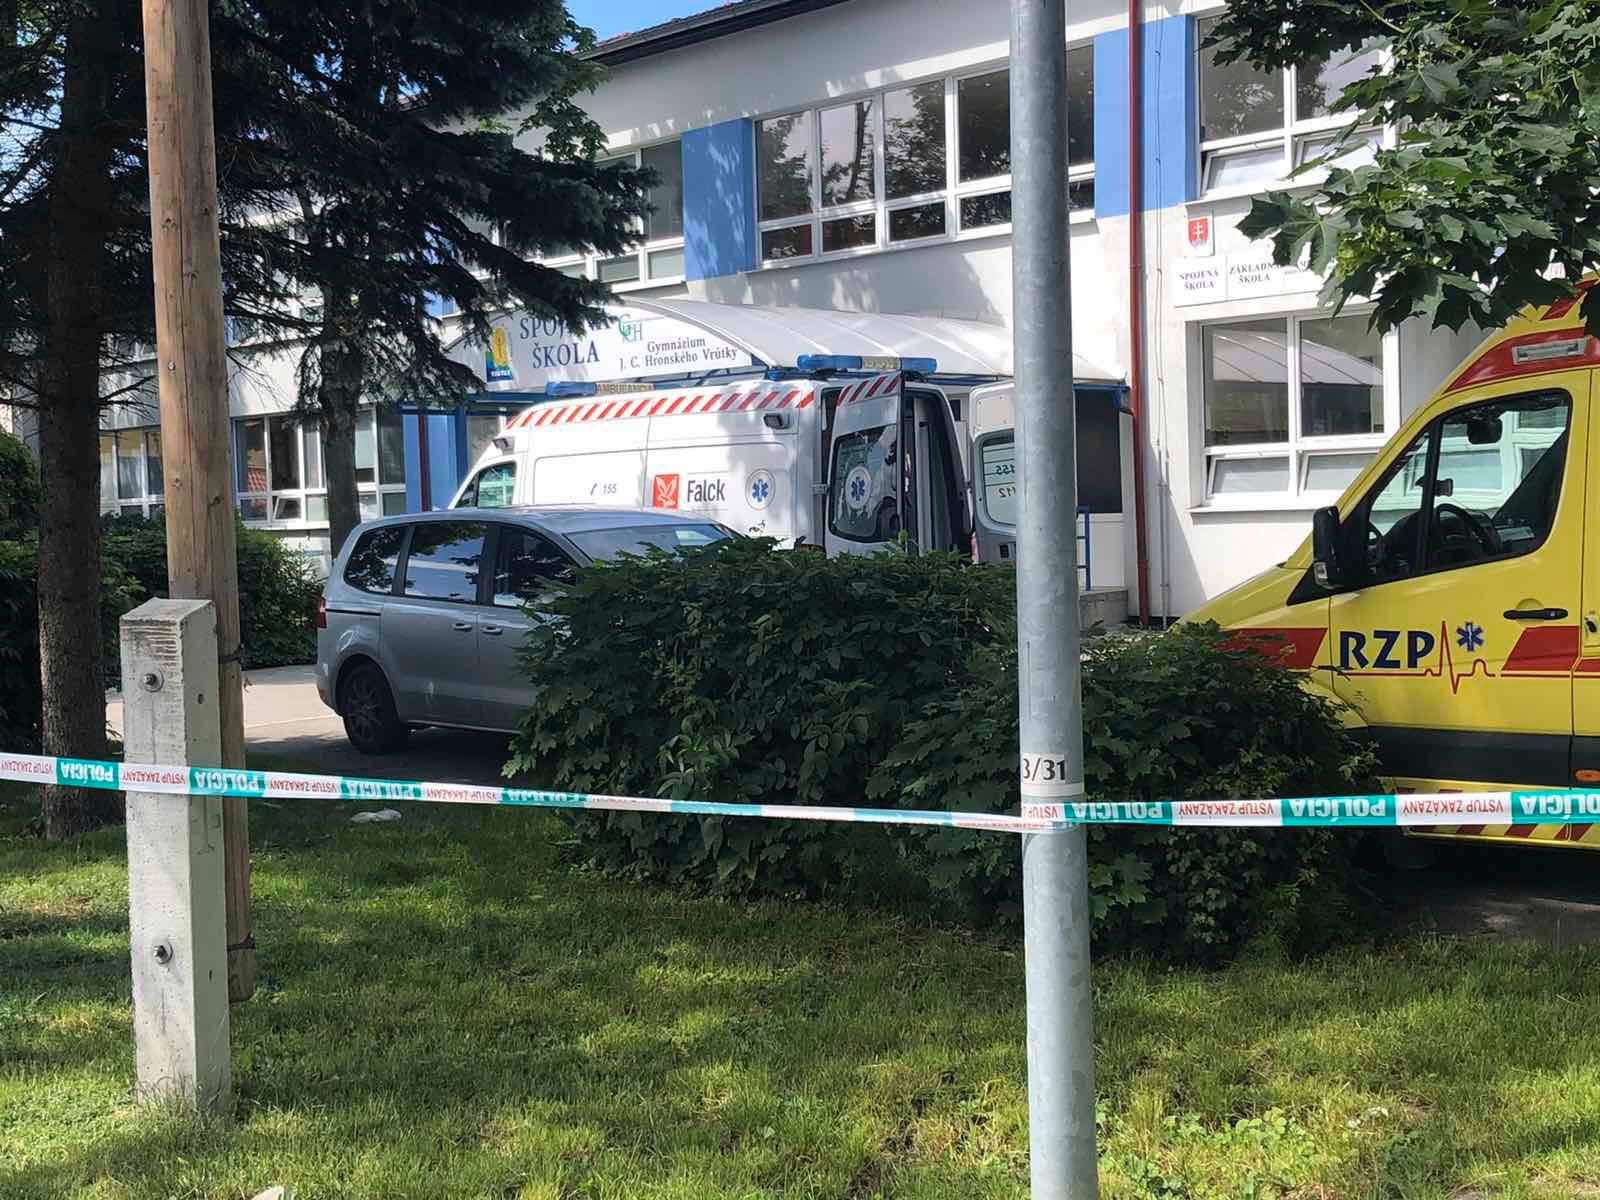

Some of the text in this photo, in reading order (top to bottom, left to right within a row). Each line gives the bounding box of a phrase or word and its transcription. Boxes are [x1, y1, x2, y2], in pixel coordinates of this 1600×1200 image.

[1184, 280, 1214, 291] ŠKOLA
[1239, 273, 1270, 284] ŠKOLA
[533, 340, 600, 368] ŠKOLA
[647, 337, 706, 355] Gymnázium
[630, 355, 641, 368] C.
[645, 351, 698, 367] Hronského
[702, 346, 738, 361] Vrútky
[687, 478, 726, 502] Falck
[1340, 629, 1435, 669] RZP
[61, 761, 114, 784] POLÍCIA
[160, 771, 186, 785] VSTUP
[311, 781, 337, 794] VSTUP
[1239, 802, 1274, 816] VSTUP
[1289, 799, 1386, 822] POLÍCIA
[1468, 799, 1504, 813] VSTUP
[1519, 794, 1600, 820] OLÍCIA
